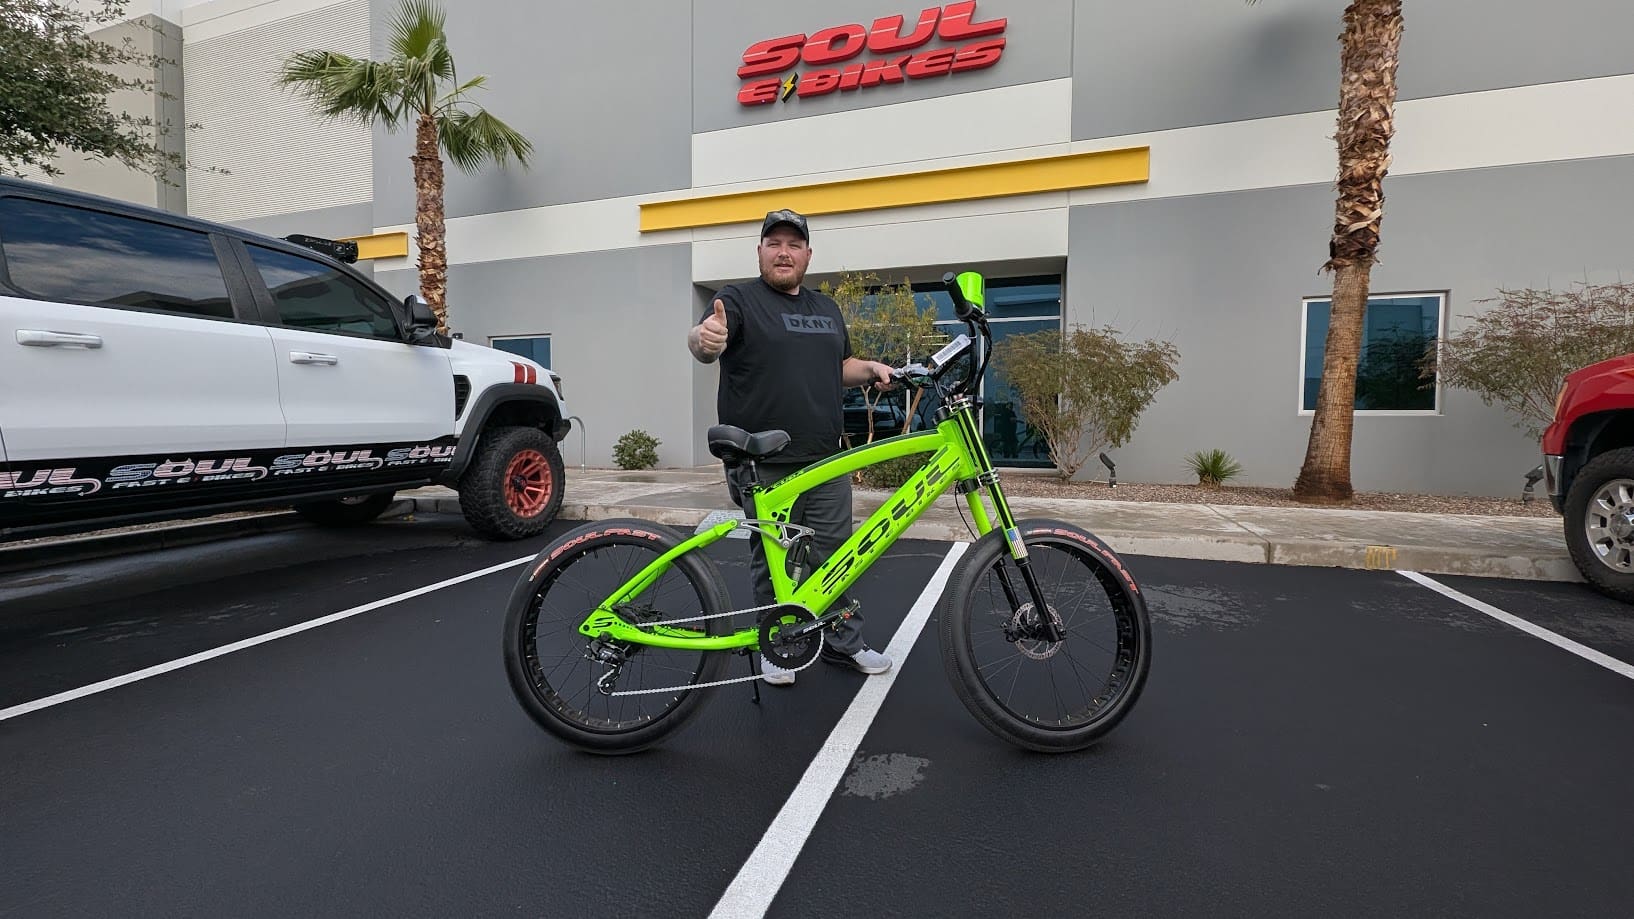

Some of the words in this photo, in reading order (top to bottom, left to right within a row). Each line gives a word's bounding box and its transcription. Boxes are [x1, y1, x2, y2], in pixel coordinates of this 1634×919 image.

[737, 0, 1007, 79] SOUL
[797, 37, 1007, 97] BIKES
[789, 318, 834, 330] DKNY
[105, 458, 268, 482] SOUL
[269, 450, 383, 471] SOUL
[4, 485, 84, 498] BIKES
[112, 479, 172, 489] FAST
[202, 472, 256, 482] BIKES
[822, 457, 960, 595] SOUL
